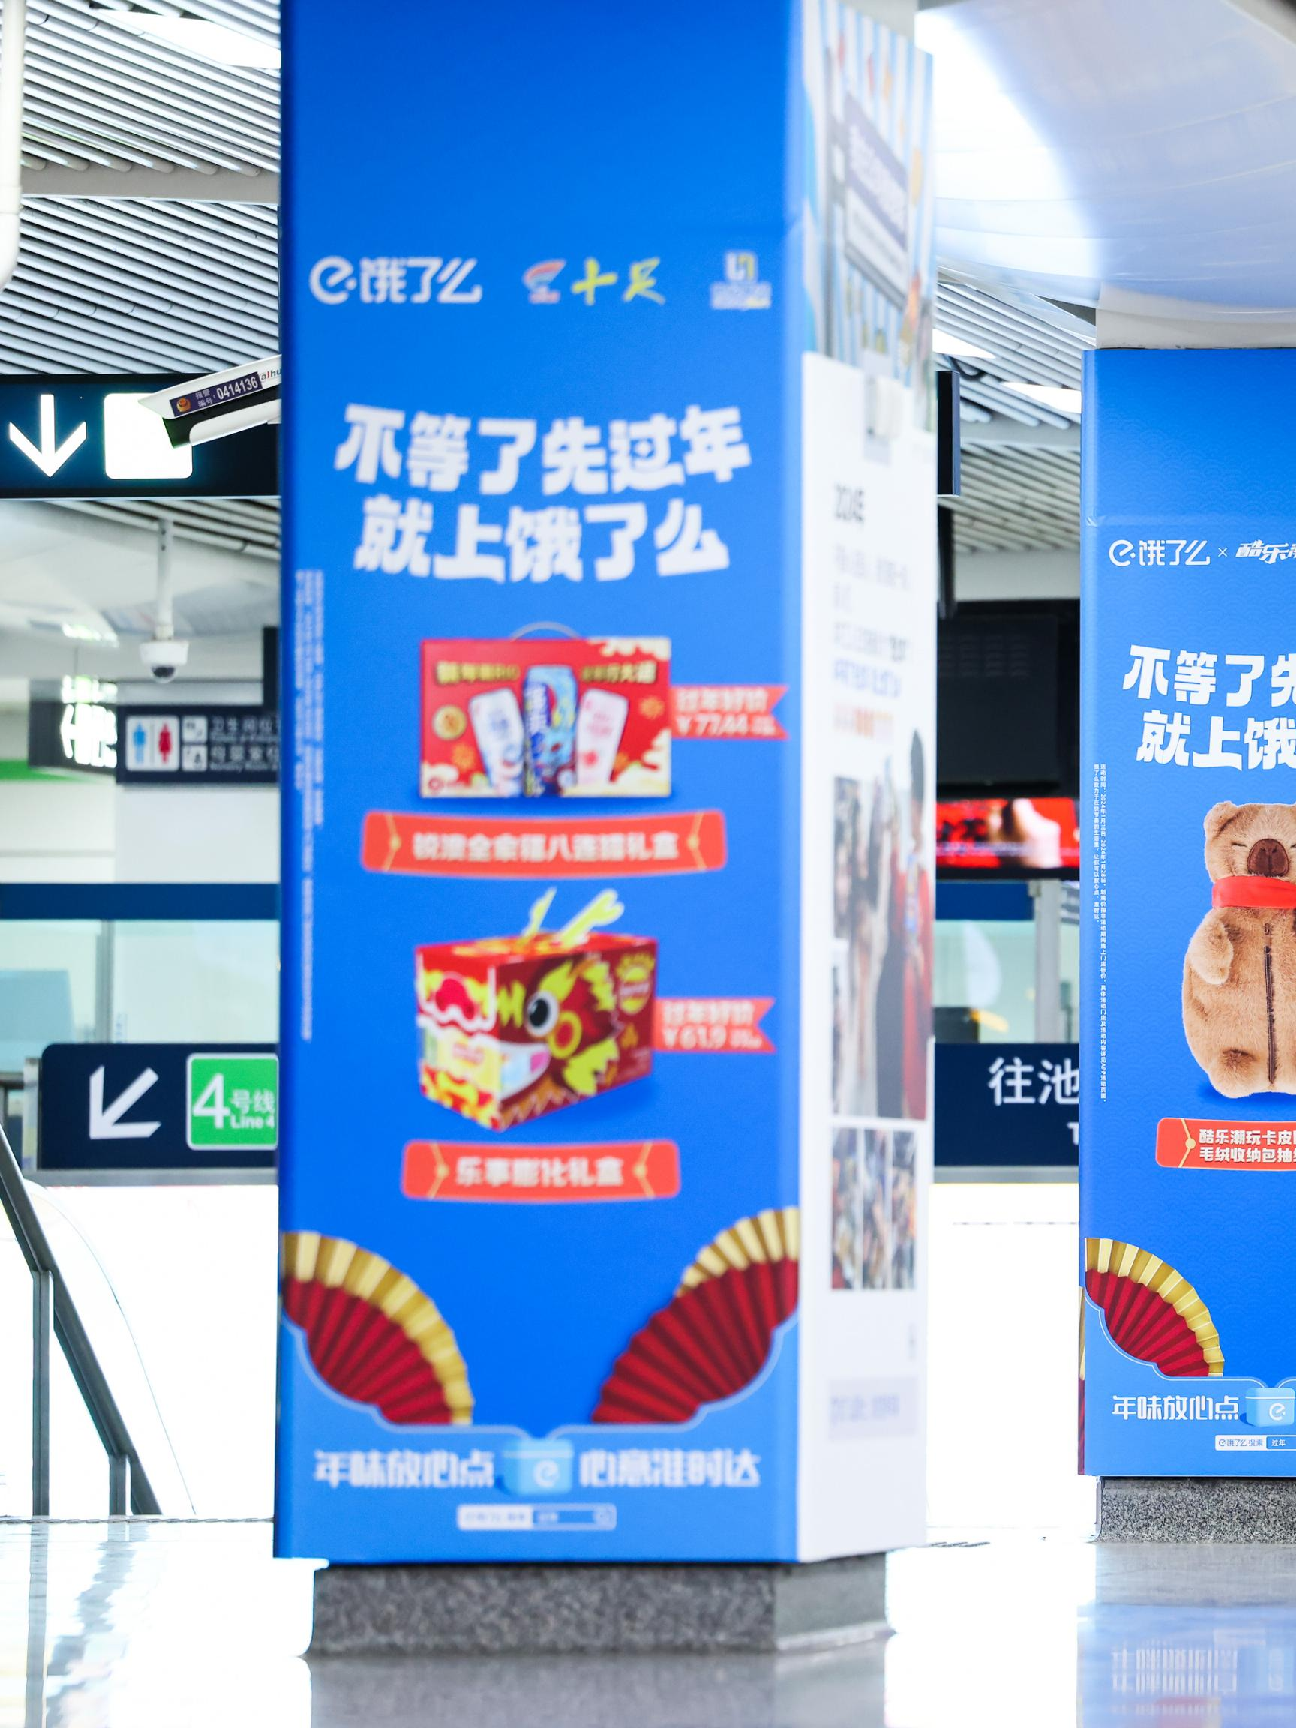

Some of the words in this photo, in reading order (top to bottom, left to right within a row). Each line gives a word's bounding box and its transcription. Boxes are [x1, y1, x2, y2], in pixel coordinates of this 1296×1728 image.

[216, 376, 258, 400] 0414136
[334, 403, 752, 496] 不等了先过年
[353, 495, 730, 583] 就上饿了么
[987, 1057, 1080, 1107] 往池
[230, 1114, 264, 1130] Line
[1111, 1394, 1239, 1421] 年味放心点
[313, 1448, 495, 1488] 年味放心点
[579, 1448, 761, 1488] 心意准时达
